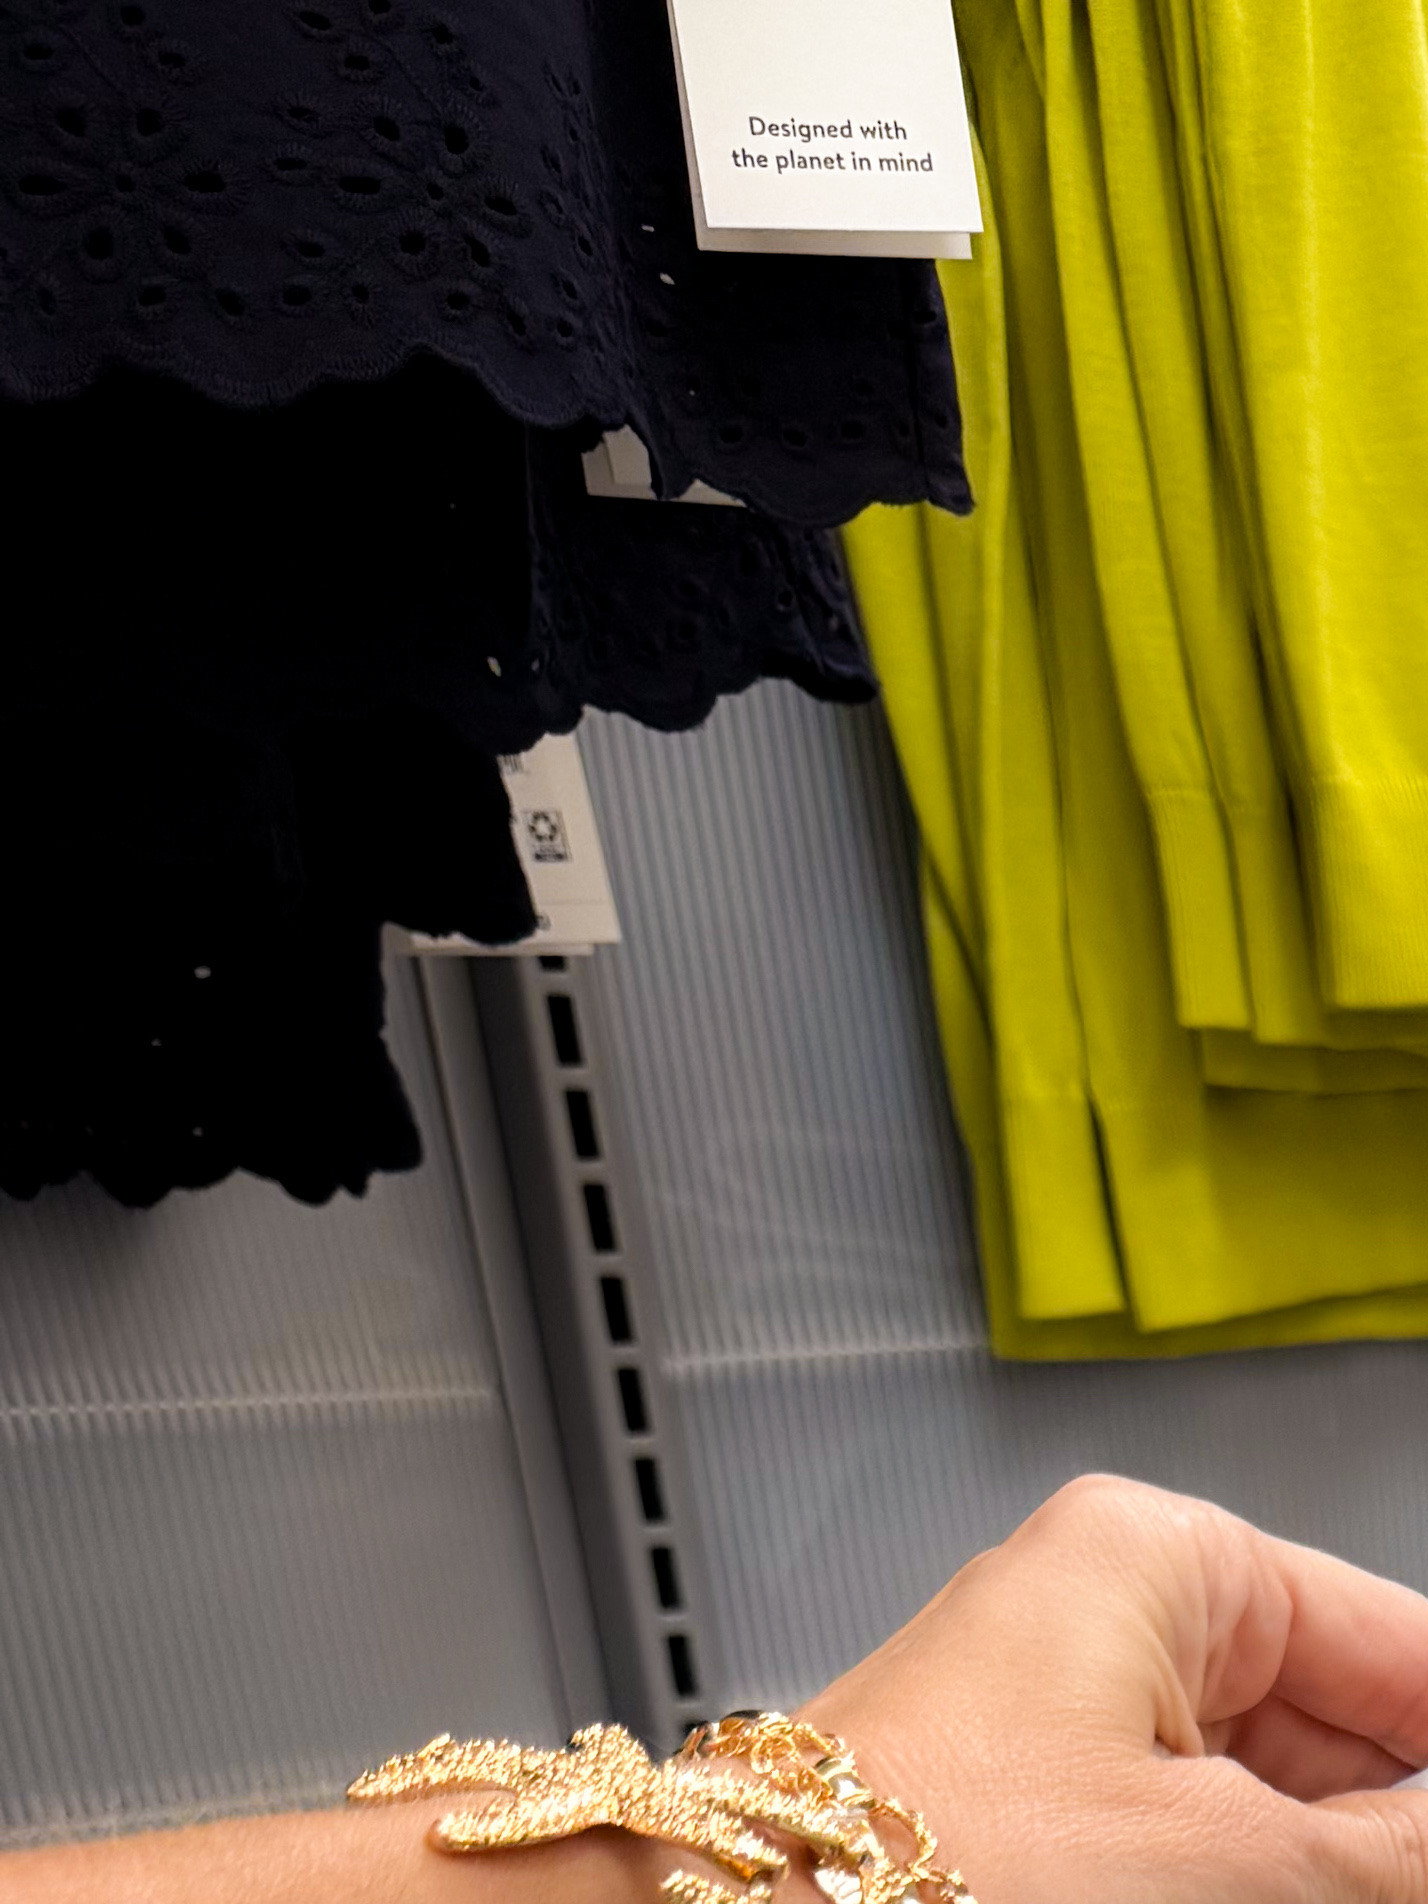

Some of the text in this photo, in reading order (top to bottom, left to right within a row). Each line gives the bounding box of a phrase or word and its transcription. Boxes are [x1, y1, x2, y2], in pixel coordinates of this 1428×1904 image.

[749, 116, 907, 143] Designed with
[732, 148, 933, 174] the planet in mind
